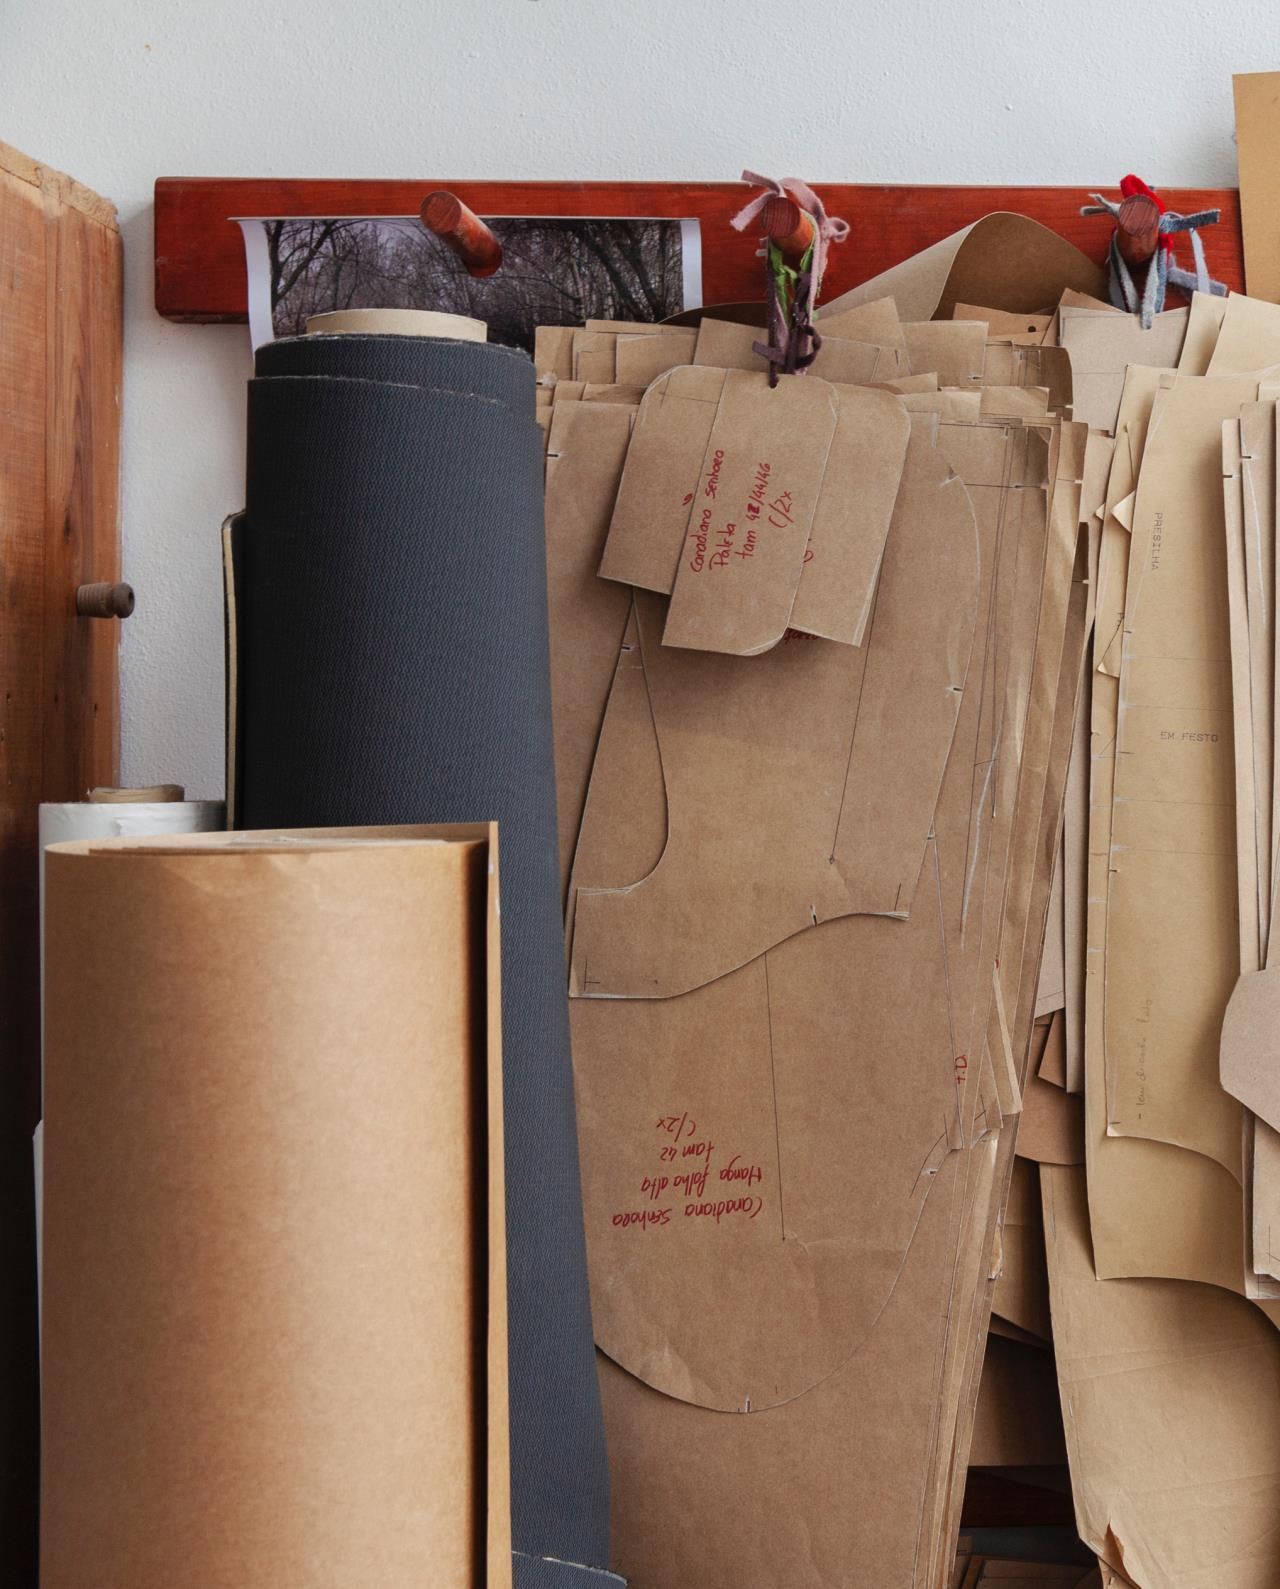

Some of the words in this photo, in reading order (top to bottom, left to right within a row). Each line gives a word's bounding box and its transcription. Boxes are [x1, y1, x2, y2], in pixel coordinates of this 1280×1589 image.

[690, 508, 712, 573] Canadiana
[709, 523, 737, 570] Paleta
[735, 530, 757, 559] tam
[1151, 512, 1162, 571] PRESILHA
[1160, 731, 1175, 740] EM
[1182, 732, 1218, 743] FESTO
[659, 1147, 677, 1162] 42
[682, 1140, 715, 1163] tam
[685, 1196, 763, 1224] Canadiana
